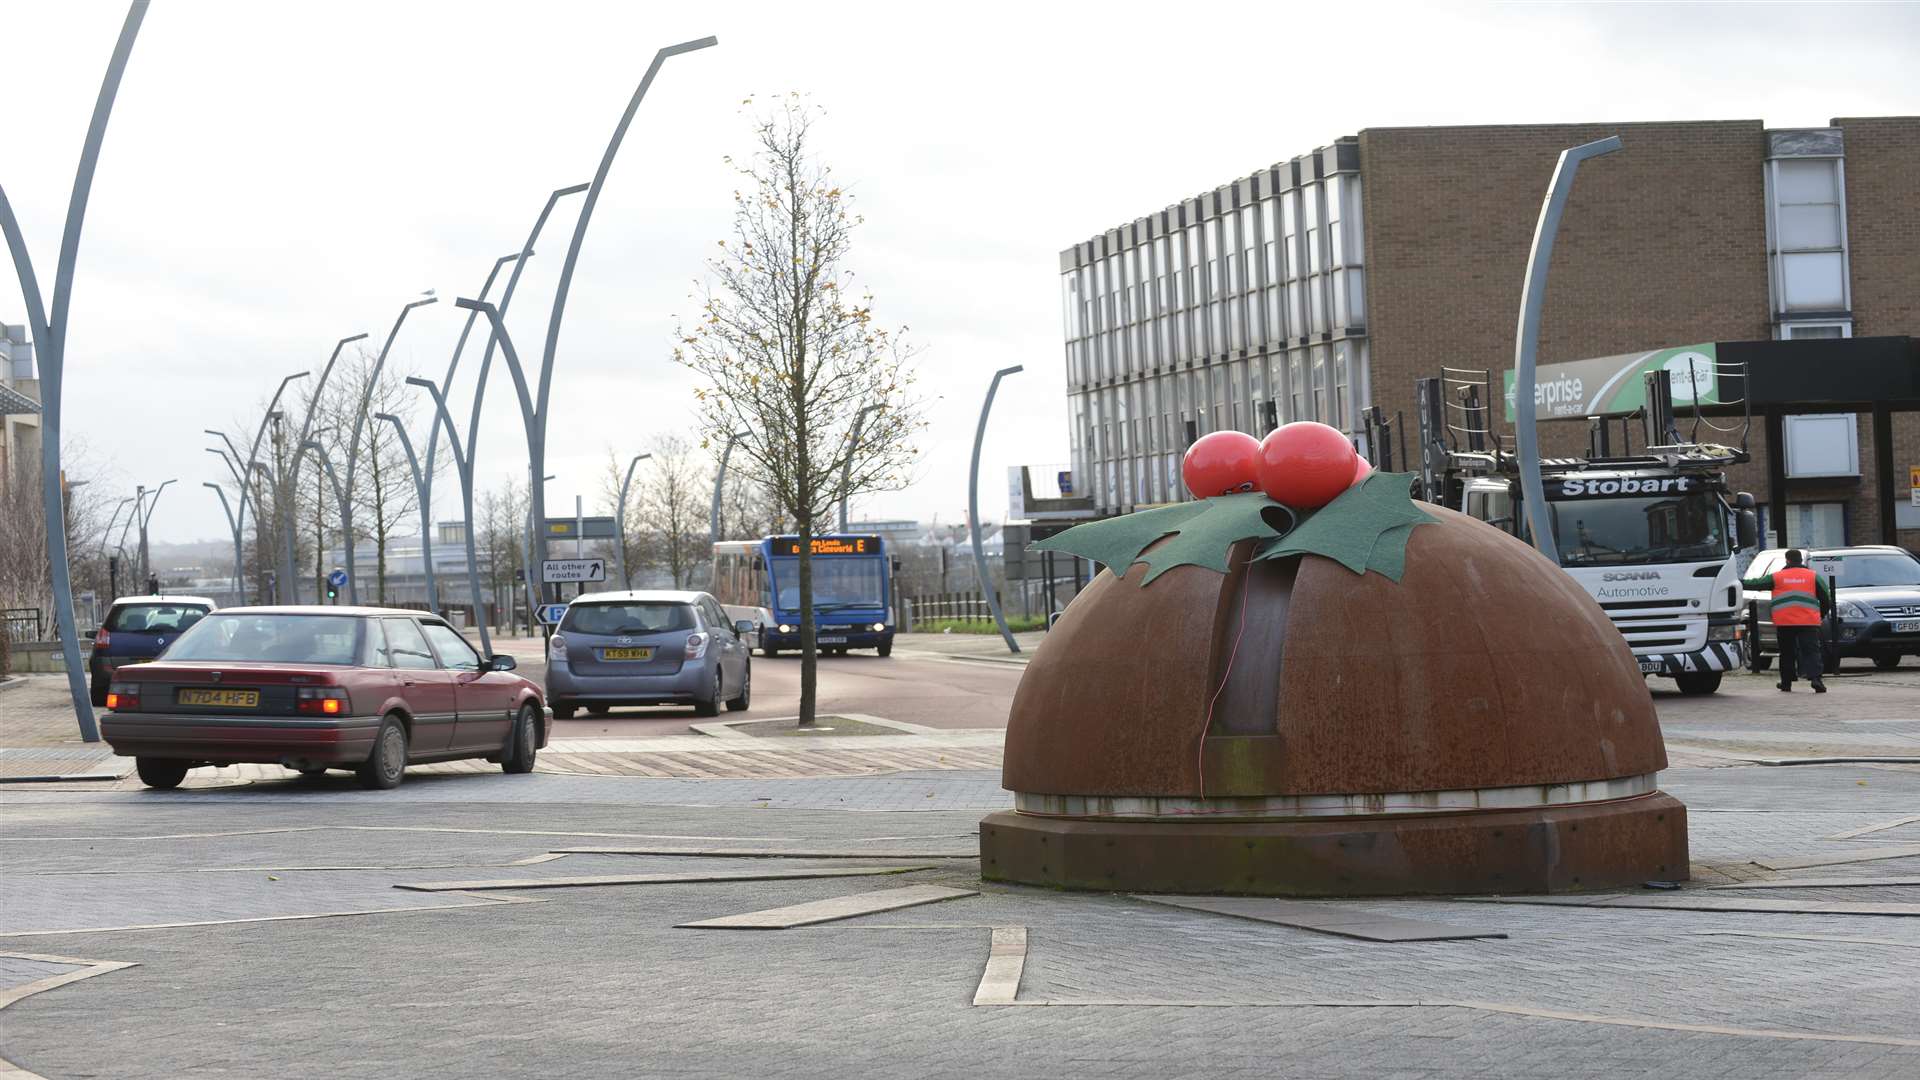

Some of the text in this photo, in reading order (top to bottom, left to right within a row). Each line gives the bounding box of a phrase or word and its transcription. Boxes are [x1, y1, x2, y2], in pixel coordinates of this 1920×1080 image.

[1534, 372, 1583, 412] erprise
[1562, 476, 1689, 496] Stobart
[857, 540, 864, 552] E
[561, 563, 586, 571] other
[551, 571, 581, 579] routes
[1602, 571, 1661, 582] SCANIA
[1597, 585, 1669, 598] Automotive
[553, 608, 564, 620] P
[181, 691, 257, 705] N704 HFB
